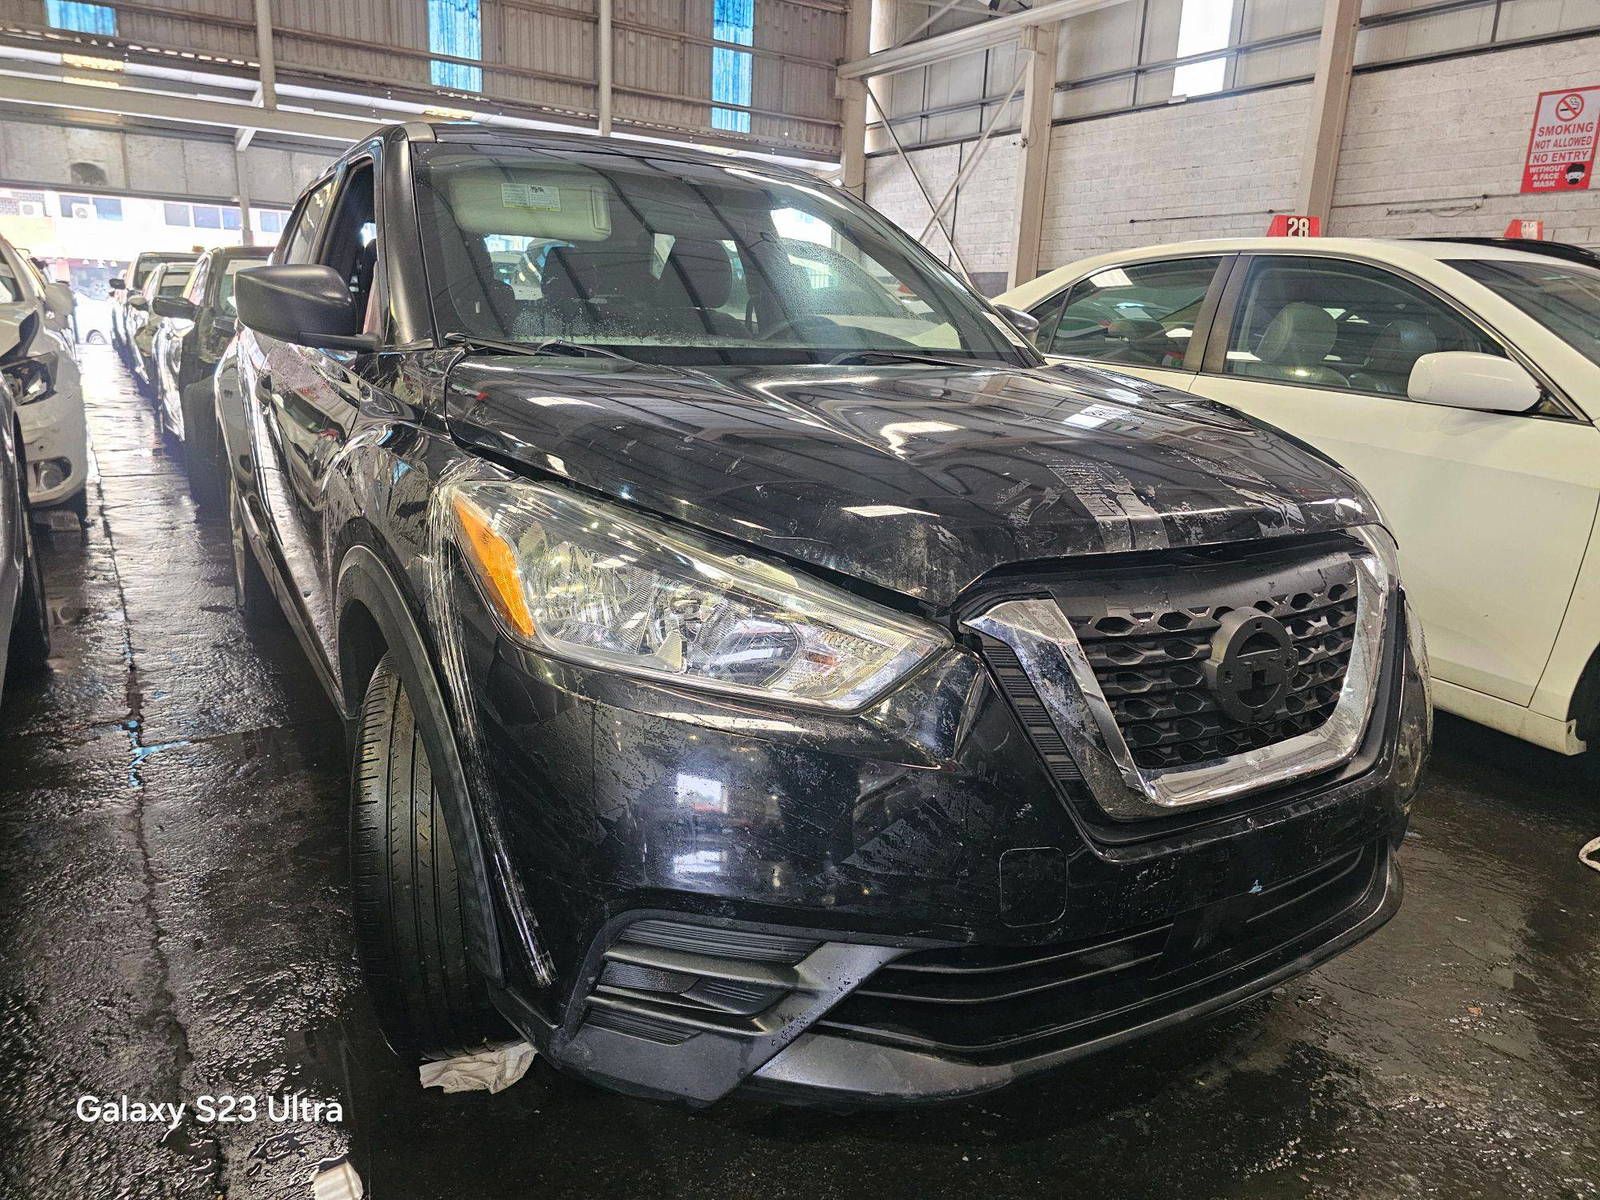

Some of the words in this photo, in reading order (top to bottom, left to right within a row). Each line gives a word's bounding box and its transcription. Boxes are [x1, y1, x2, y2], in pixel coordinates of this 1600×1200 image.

[1537, 122, 1594, 137] SMOKING
[1534, 140, 1551, 150] NOT
[1553, 136, 1592, 148] ALLOWED
[1532, 154, 1549, 163] NO
[1551, 151, 1589, 162] ENTRY
[1288, 217, 1309, 238] 28
